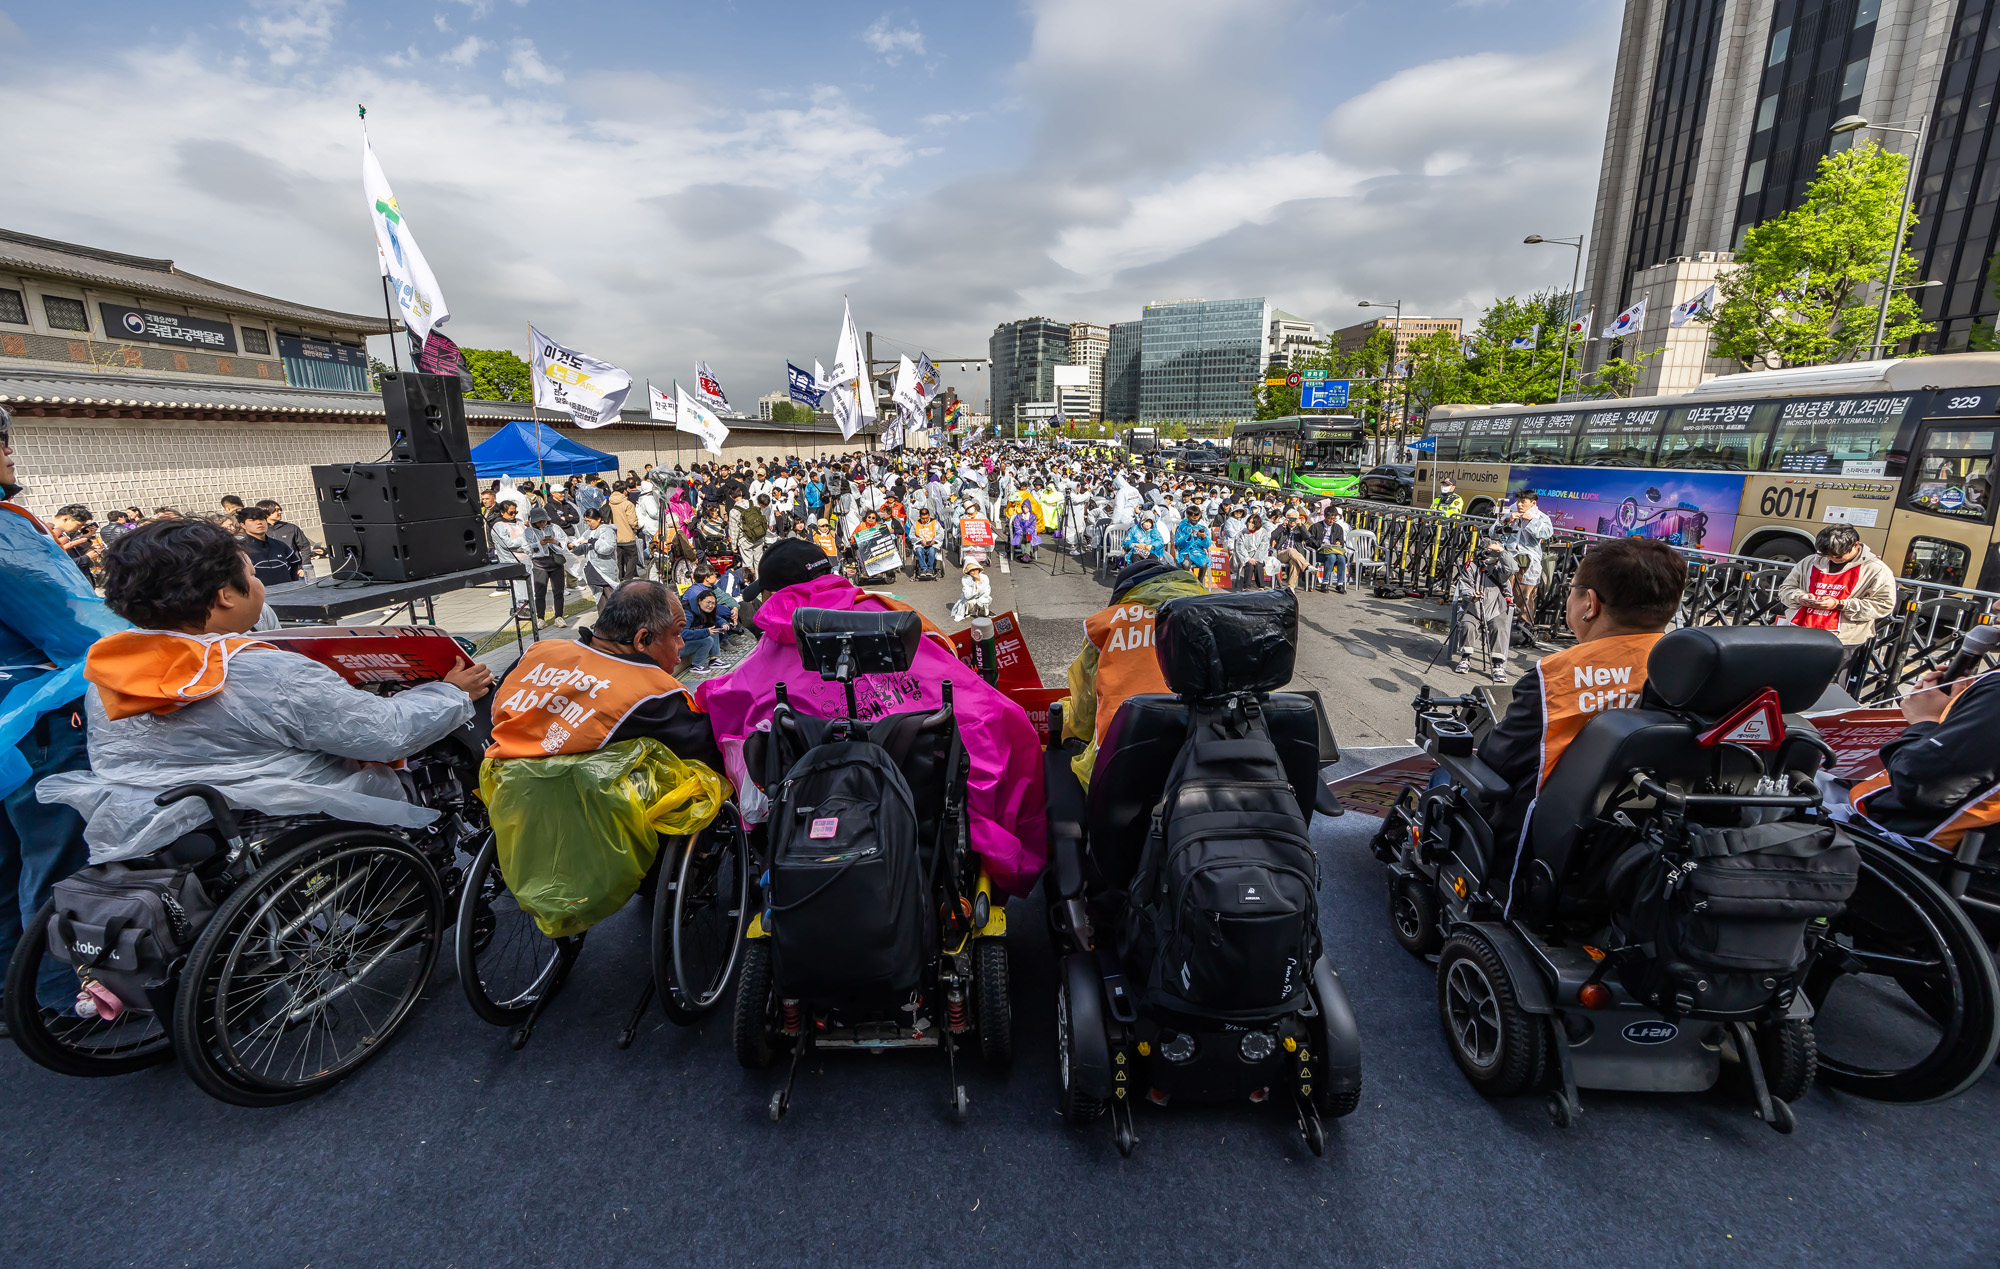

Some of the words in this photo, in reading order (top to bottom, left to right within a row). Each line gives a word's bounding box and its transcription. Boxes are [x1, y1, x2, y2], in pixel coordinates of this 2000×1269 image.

[147, 322, 225, 346] 국립고궁박물관
[544, 344, 584, 370] 이것도
[552, 364, 579, 383] 노동
[1782, 400, 1835, 419] 인천공항
[1835, 396, 1910, 416] 제1,2터미널
[1947, 396, 1981, 409] 329
[1625, 409, 1660, 426] 연세대
[1686, 404, 1756, 424] 마포구청역
[1813, 418, 1841, 426] AIRPORT
[1842, 417, 1876, 425] TERMINAL
[1428, 467, 1456, 480] Airport
[1456, 468, 1499, 484] Limousine
[1870, 467, 1881, 475] 카페
[1547, 489, 1568, 498] ABOVE
[1568, 490, 1580, 499] ALL
[1581, 492, 1600, 501] LUCK
[1813, 481, 1894, 493] GRANBIRD
[1760, 486, 1819, 520] 6011
[1574, 665, 1632, 688] New
